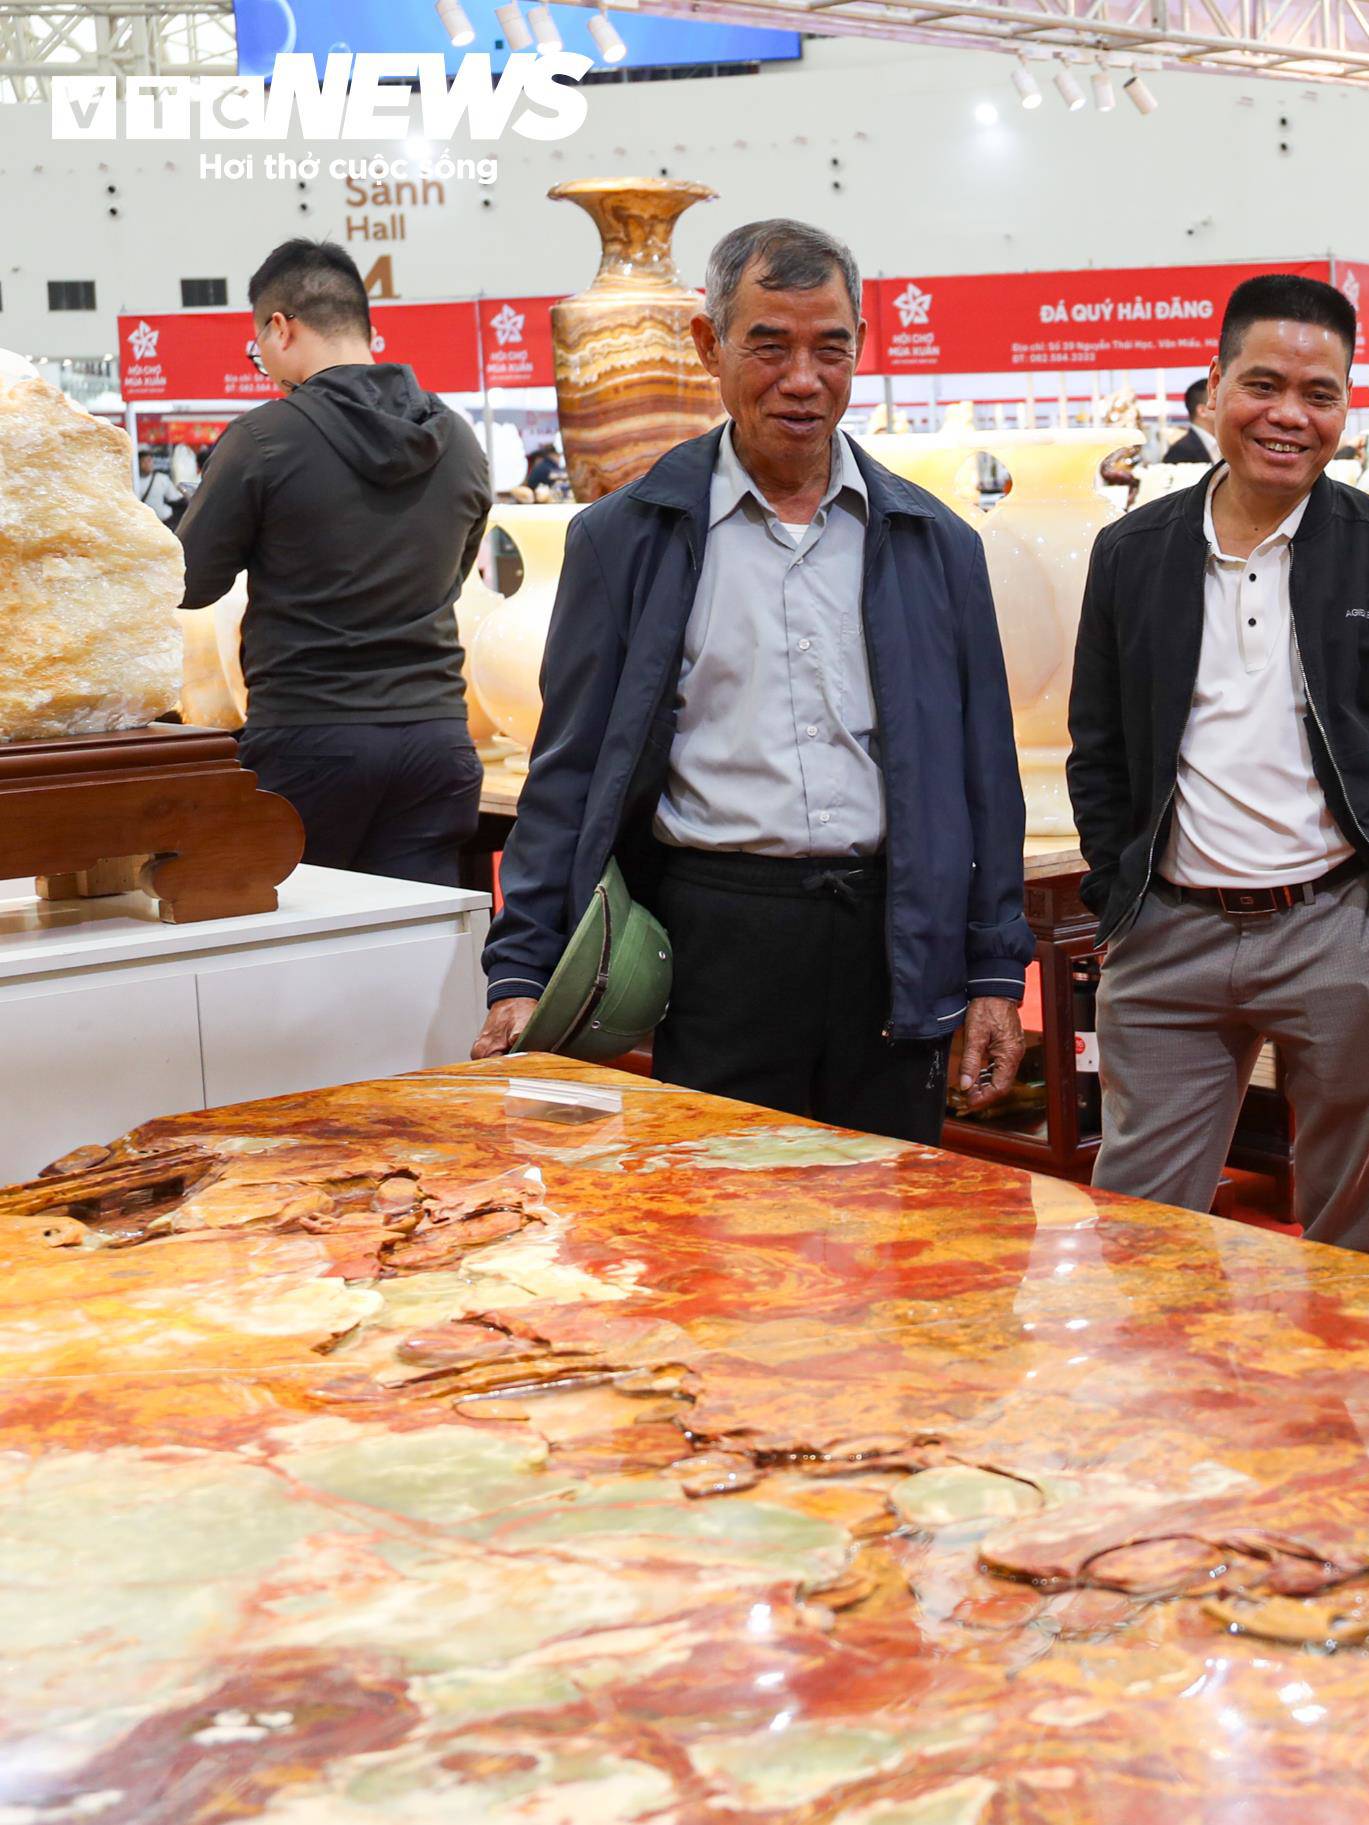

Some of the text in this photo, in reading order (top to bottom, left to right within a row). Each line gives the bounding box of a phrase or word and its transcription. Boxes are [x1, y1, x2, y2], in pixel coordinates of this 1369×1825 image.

[345, 213, 406, 241] Hall
[1039, 296, 1213, 323] ĐÁ QUÝ HẢI ĐĂNG
